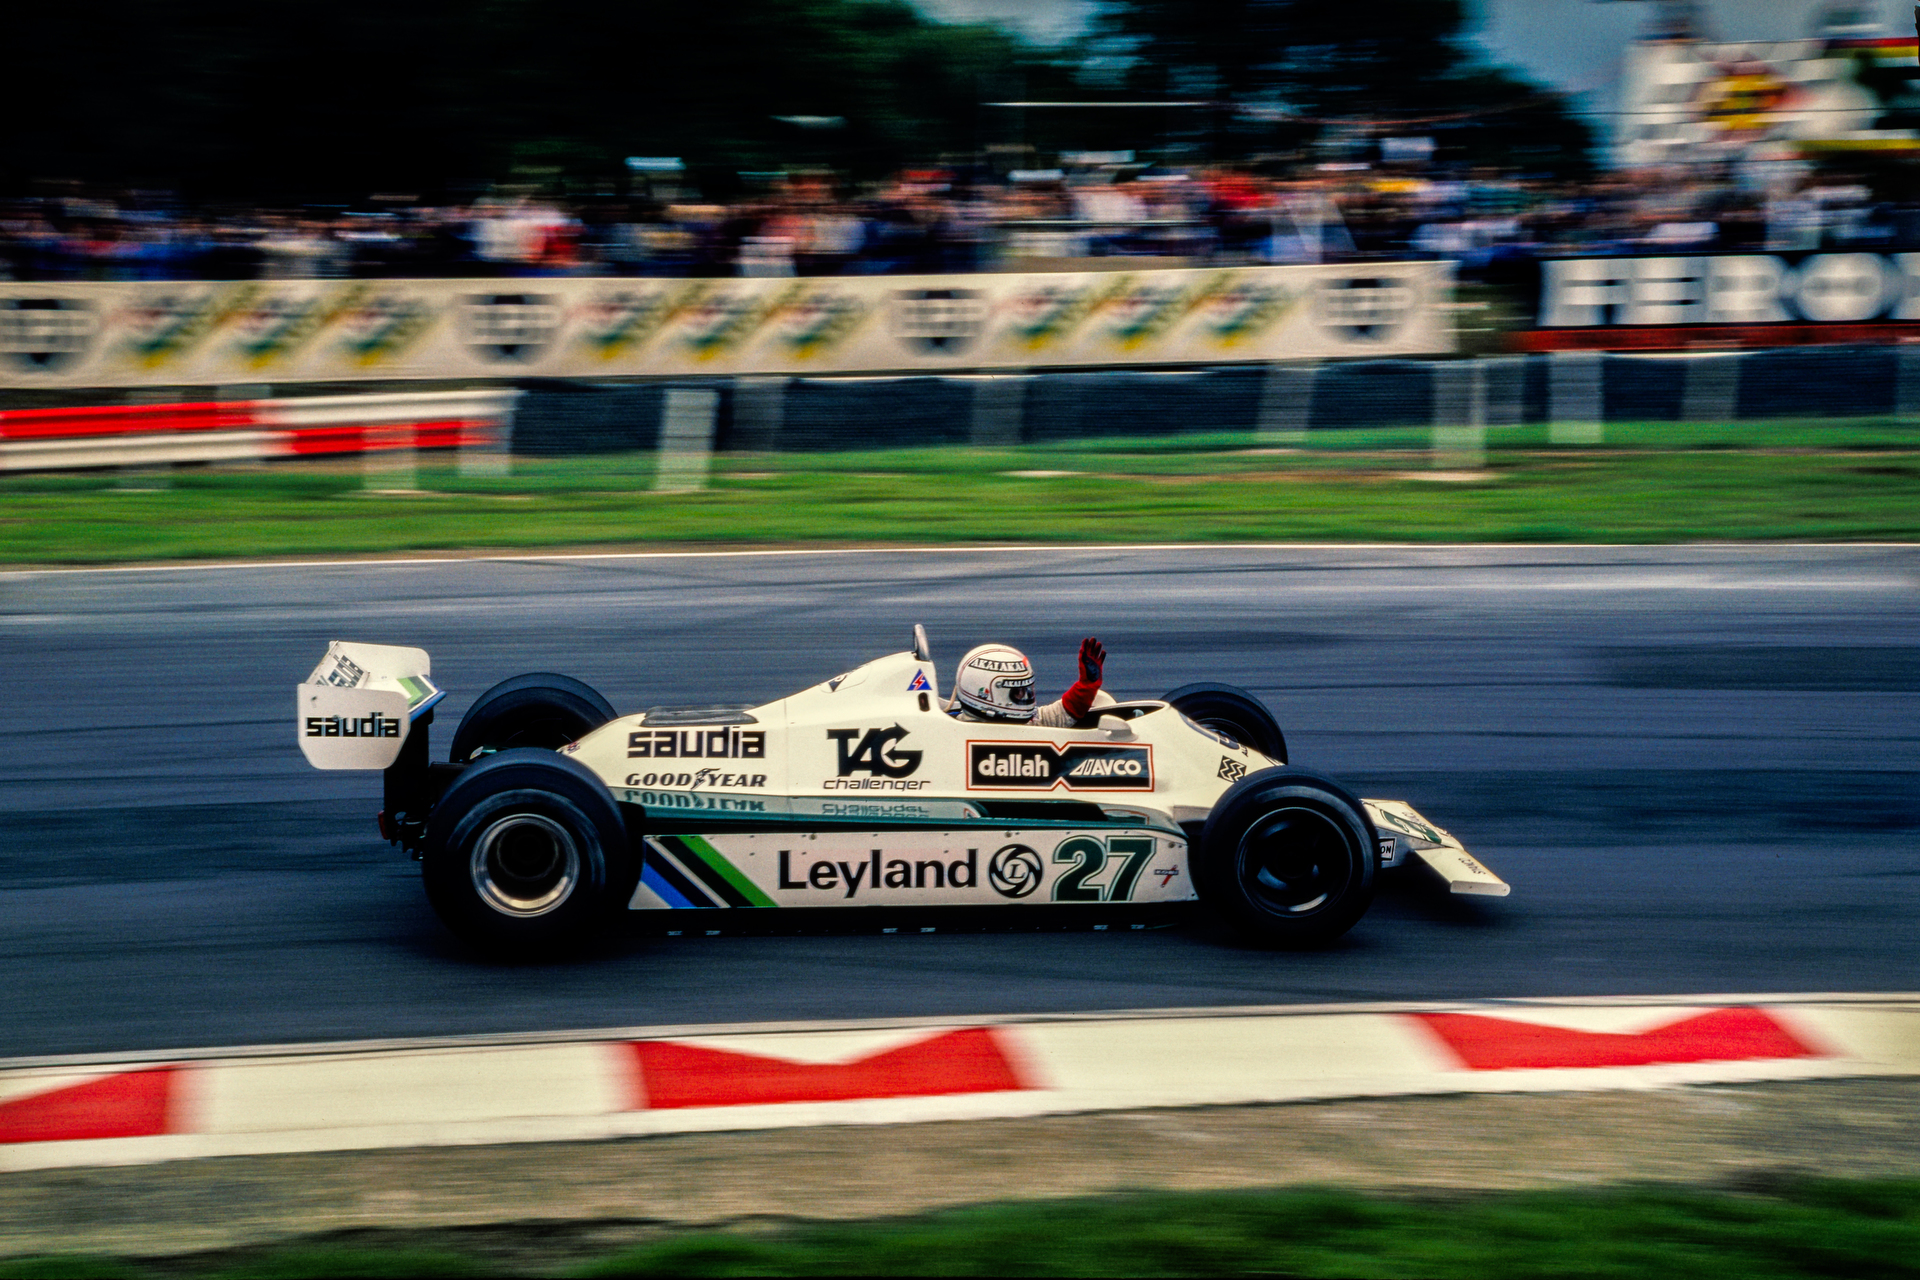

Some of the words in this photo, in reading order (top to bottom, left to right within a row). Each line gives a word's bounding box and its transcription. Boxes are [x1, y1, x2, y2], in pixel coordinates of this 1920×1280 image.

[970, 658, 1000, 671] AKAI
[1000, 661, 1026, 672] AKAI
[306, 711, 401, 738] saudia
[627, 726, 766, 759] saudia
[827, 722, 923, 779] TAG
[978, 753, 1050, 778] dallah
[823, 778, 931, 792] challenger
[778, 848, 978, 898] Leyland
[1052, 835, 1157, 901] 27
